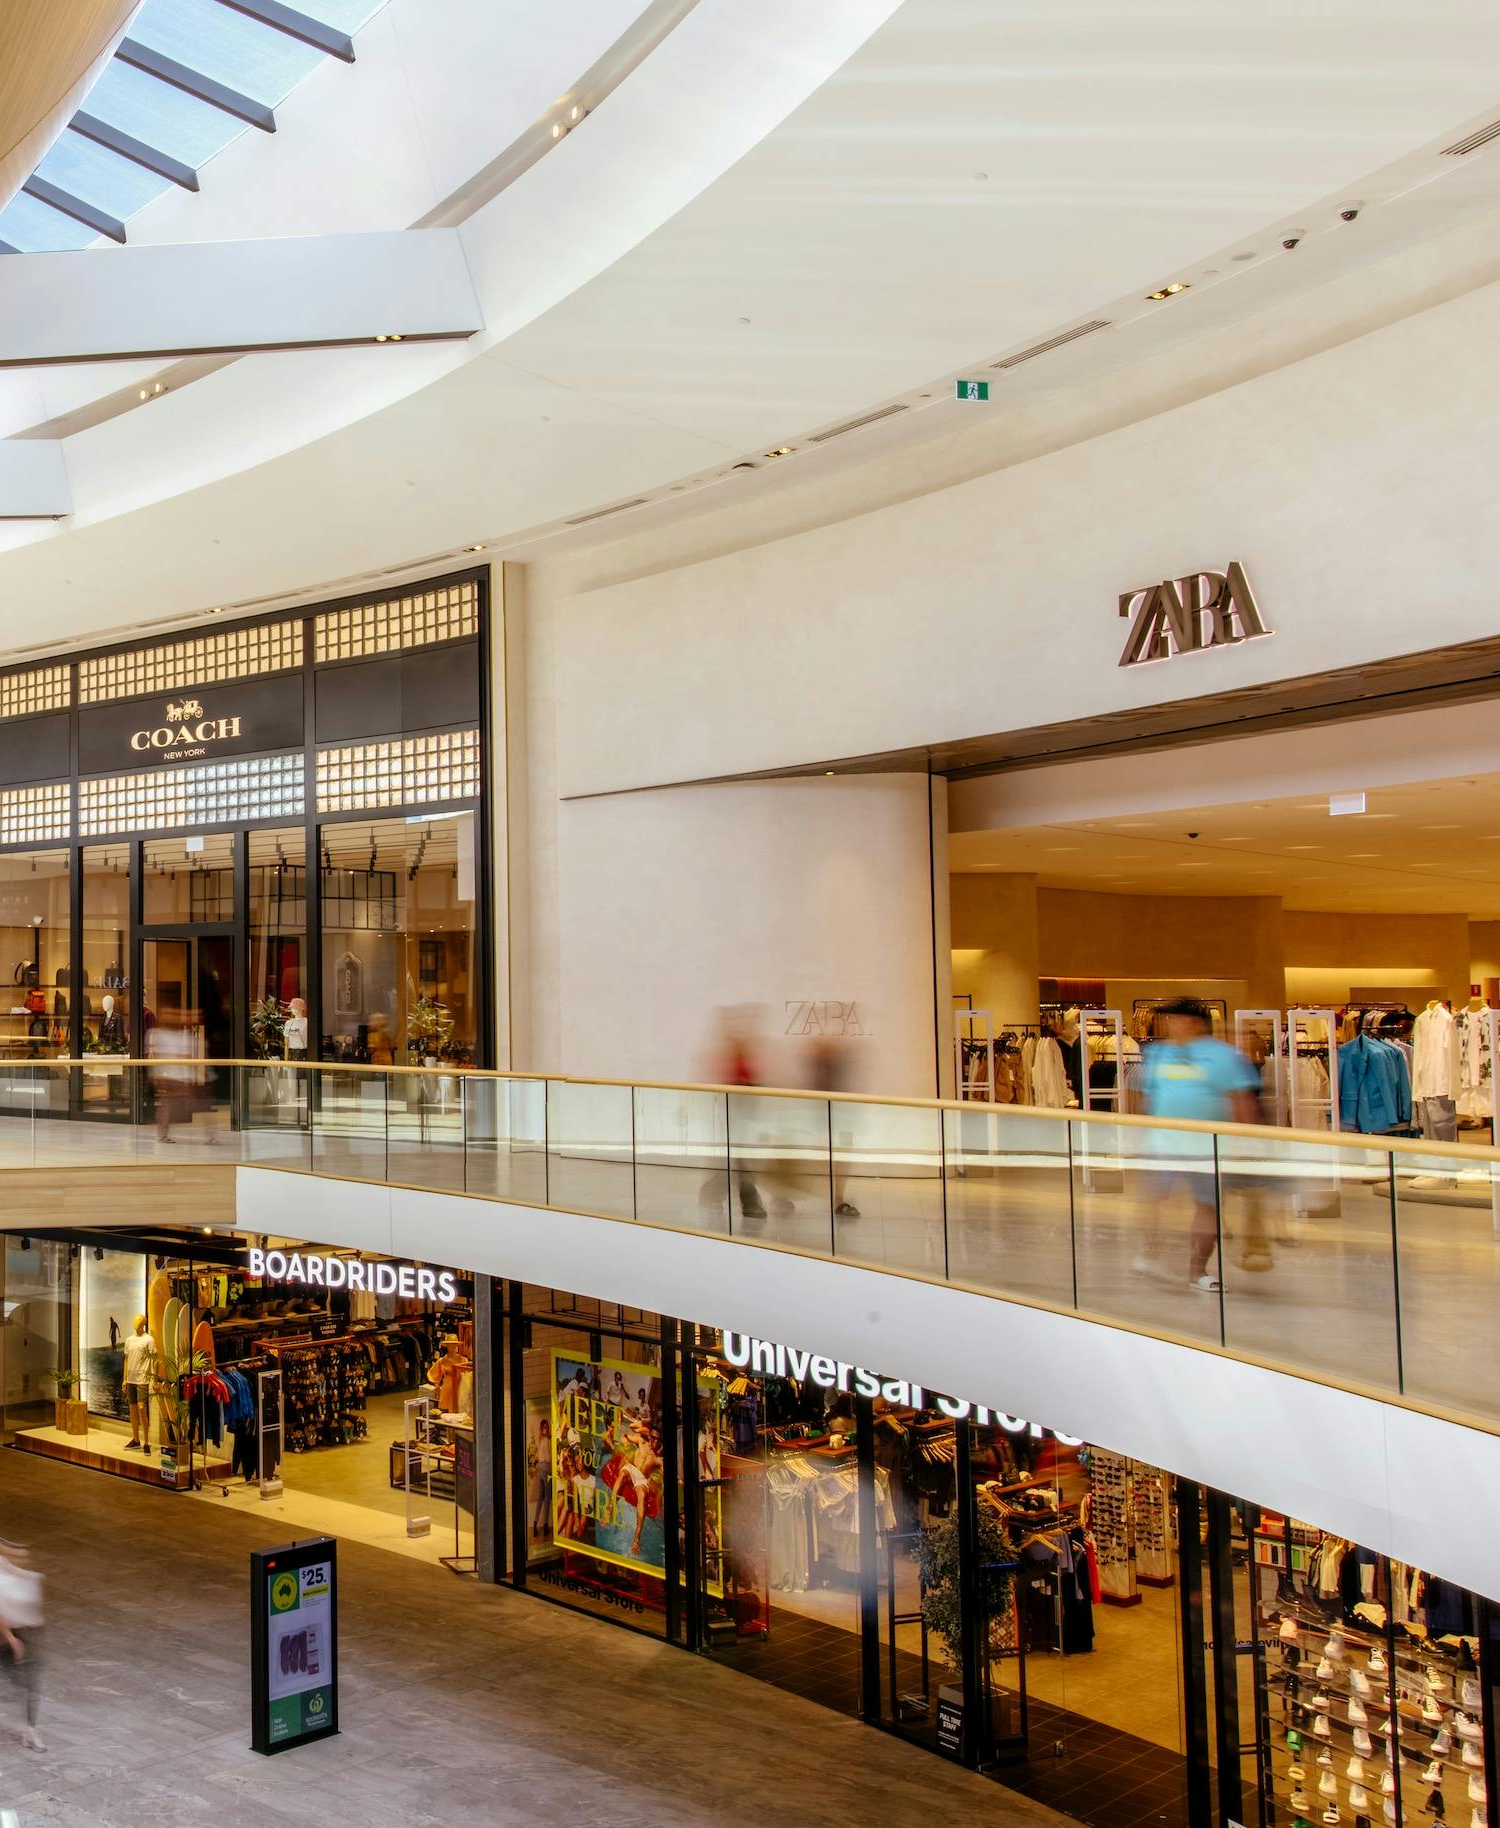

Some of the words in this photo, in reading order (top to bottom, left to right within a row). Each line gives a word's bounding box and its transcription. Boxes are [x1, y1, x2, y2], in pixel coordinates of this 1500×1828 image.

[1118, 560, 1275, 668] ZARA
[130, 716, 242, 751] COACH
[163, 751, 183, 760] NEW
[184, 747, 206, 757] YORK
[784, 1000, 875, 1036] ZARA
[249, 1248, 457, 1303] BOARDRIDERS
[604, 1592, 645, 1614] Store
